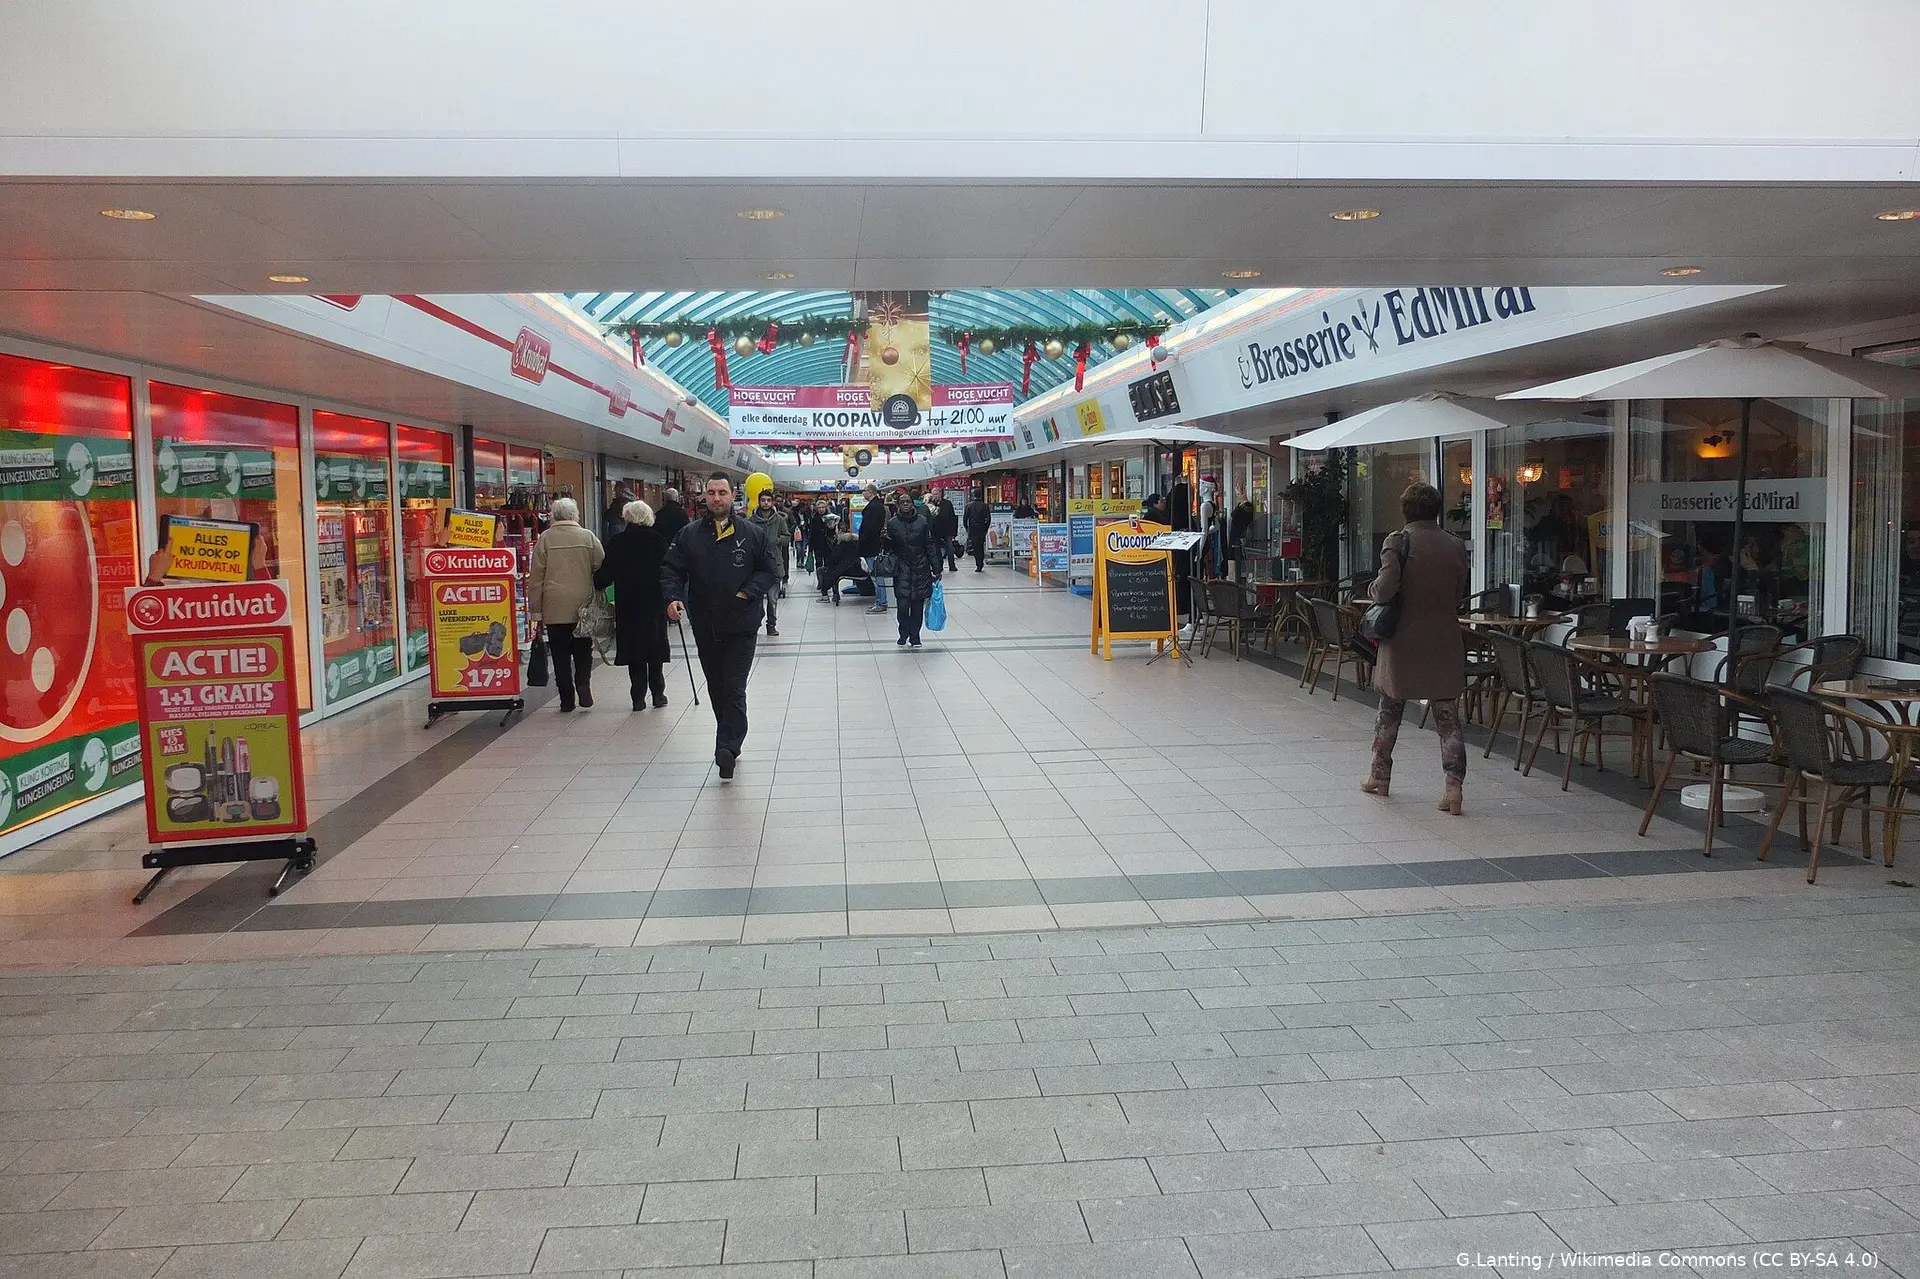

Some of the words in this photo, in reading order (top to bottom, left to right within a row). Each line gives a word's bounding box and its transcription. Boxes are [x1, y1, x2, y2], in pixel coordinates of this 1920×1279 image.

[1247, 310, 1356, 384] Brasserie
[520, 335, 549, 375] Kruidvat
[733, 391, 760, 401] HOGE
[762, 392, 796, 401] VUCHT
[836, 392, 864, 402] HOGE
[948, 390, 975, 400] HOGE
[977, 388, 1009, 399] VUCHT
[741, 413, 760, 423] elke
[762, 413, 808, 426] donderdag
[926, 410, 947, 427] tot
[988, 413, 1008, 424] uur
[805, 428, 940, 438] www.winkelcentrumhogevucht.nl
[1101, 501, 1136, 512] D-reizen
[1661, 492, 1721, 510] Brasserie
[1743, 491, 1800, 510] EdMiral
[464, 519, 484, 527] ALLES
[195, 533, 228, 546] ALLES
[1107, 531, 1162, 552] Chocom
[180, 546, 195, 557] NU
[198, 547, 223, 559] OOK
[225, 550, 240, 560] OP
[175, 559, 243, 574] KRUIDVAT.NL
[448, 554, 509, 569] Kruidvat
[442, 586, 502, 602] ACTIE!
[167, 592, 277, 620] Kruidvat
[439, 615, 490, 623] WEEKENDTAS
[161, 647, 268, 677] ACTIE!
[159, 687, 195, 707] 1+1
[200, 682, 275, 704] GRATIS
[160, 727, 183, 738] KIES
[163, 743, 185, 754] MIX
[16, 769, 75, 810] KLINGELINGELING
